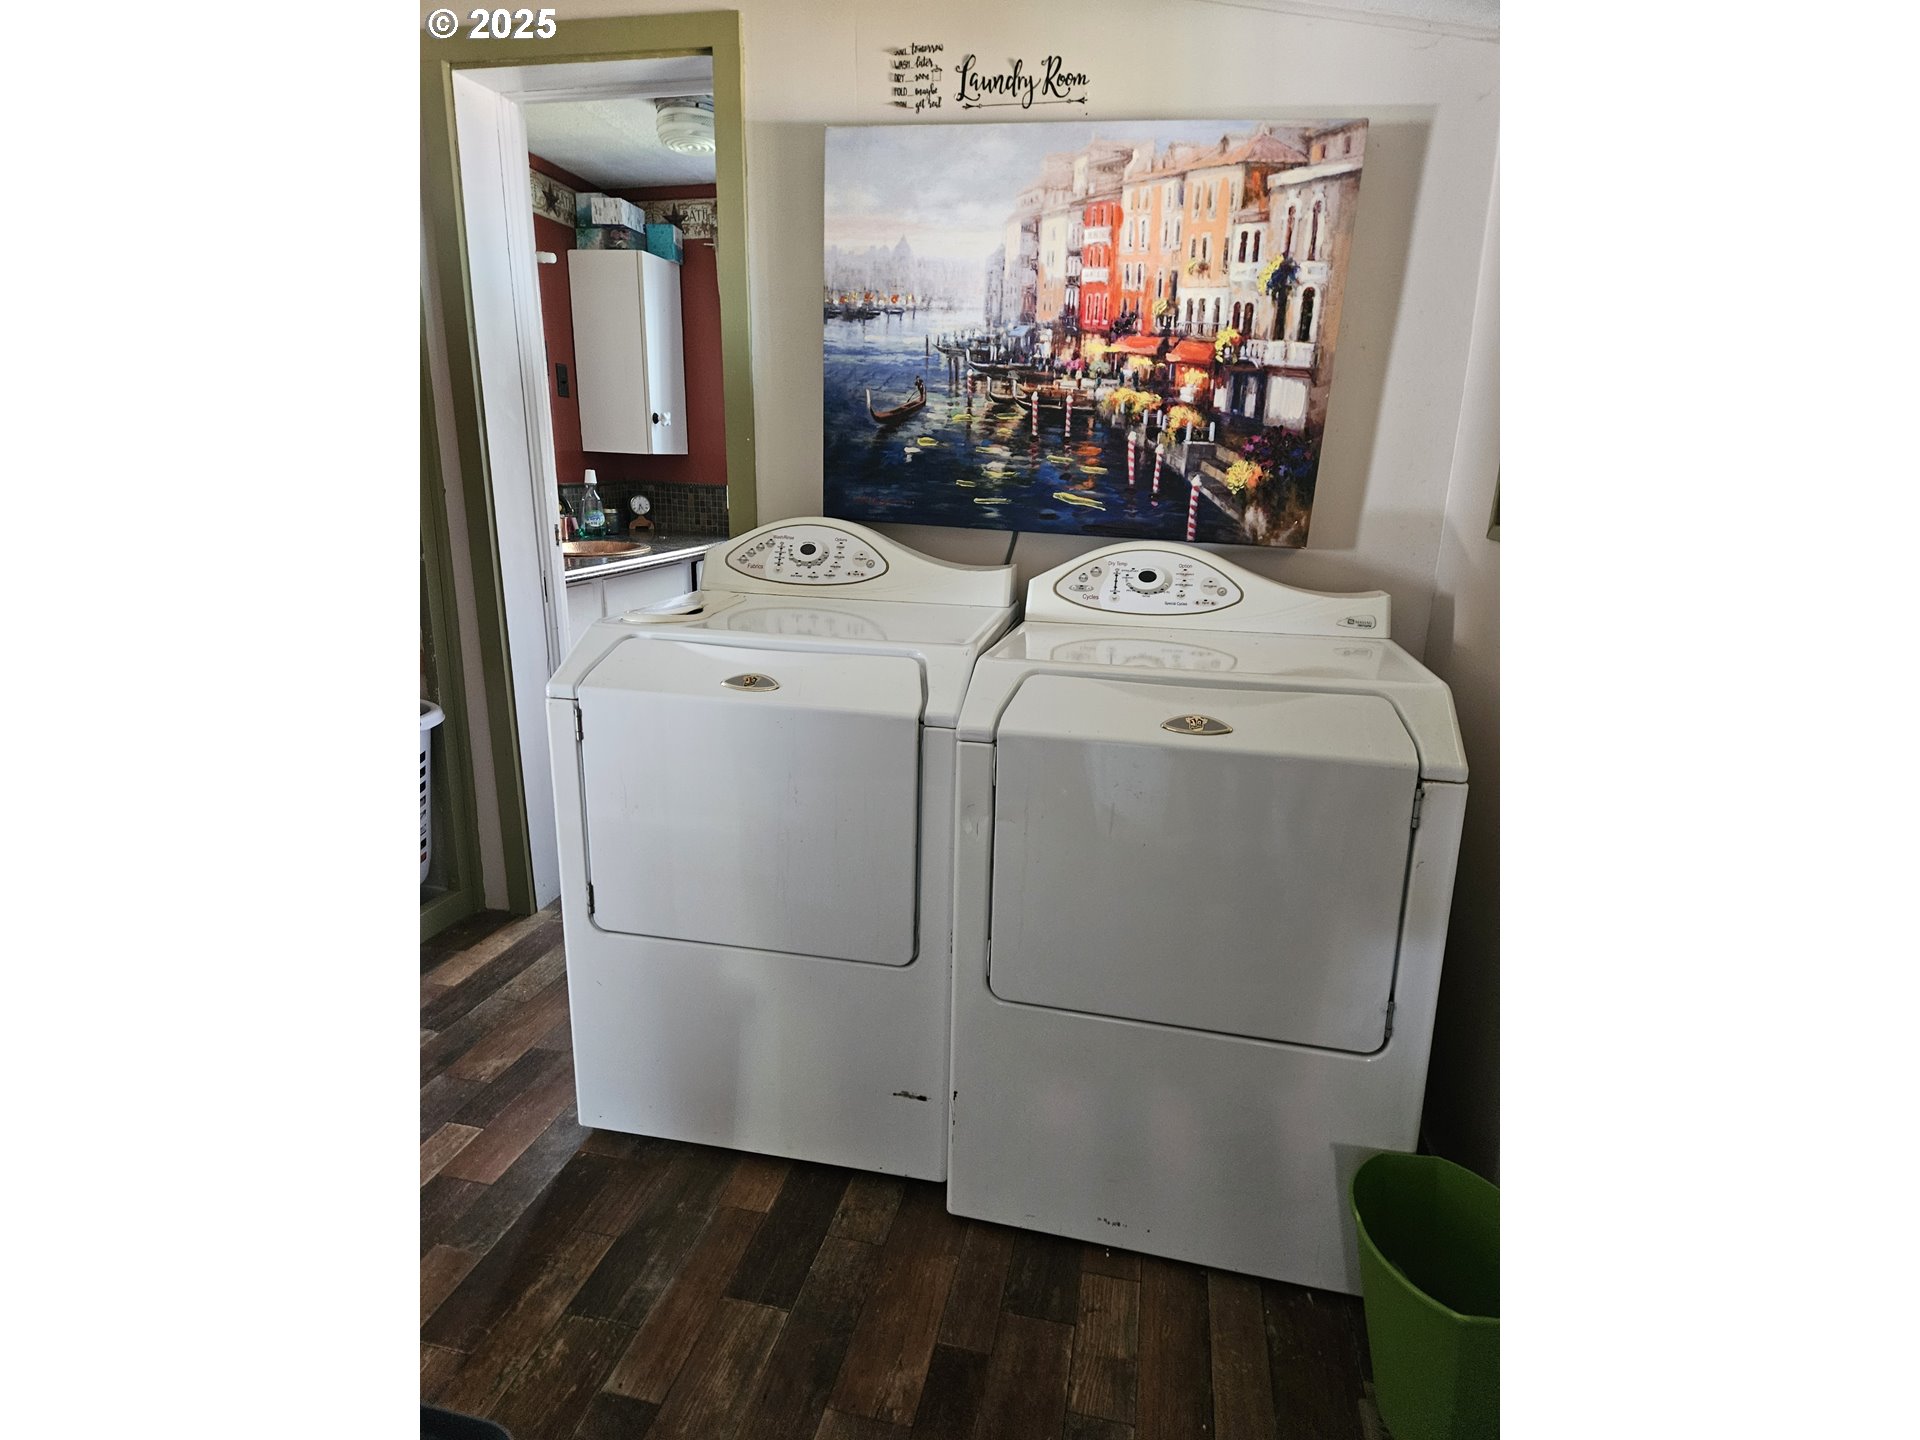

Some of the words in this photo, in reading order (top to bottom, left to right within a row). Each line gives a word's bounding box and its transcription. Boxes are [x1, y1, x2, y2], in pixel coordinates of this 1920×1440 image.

[955, 54, 1041, 109] Laundry
[1041, 55, 1090, 98] Room
[915, 83, 938, 99] maybe
[682, 209, 708, 222] BATH
